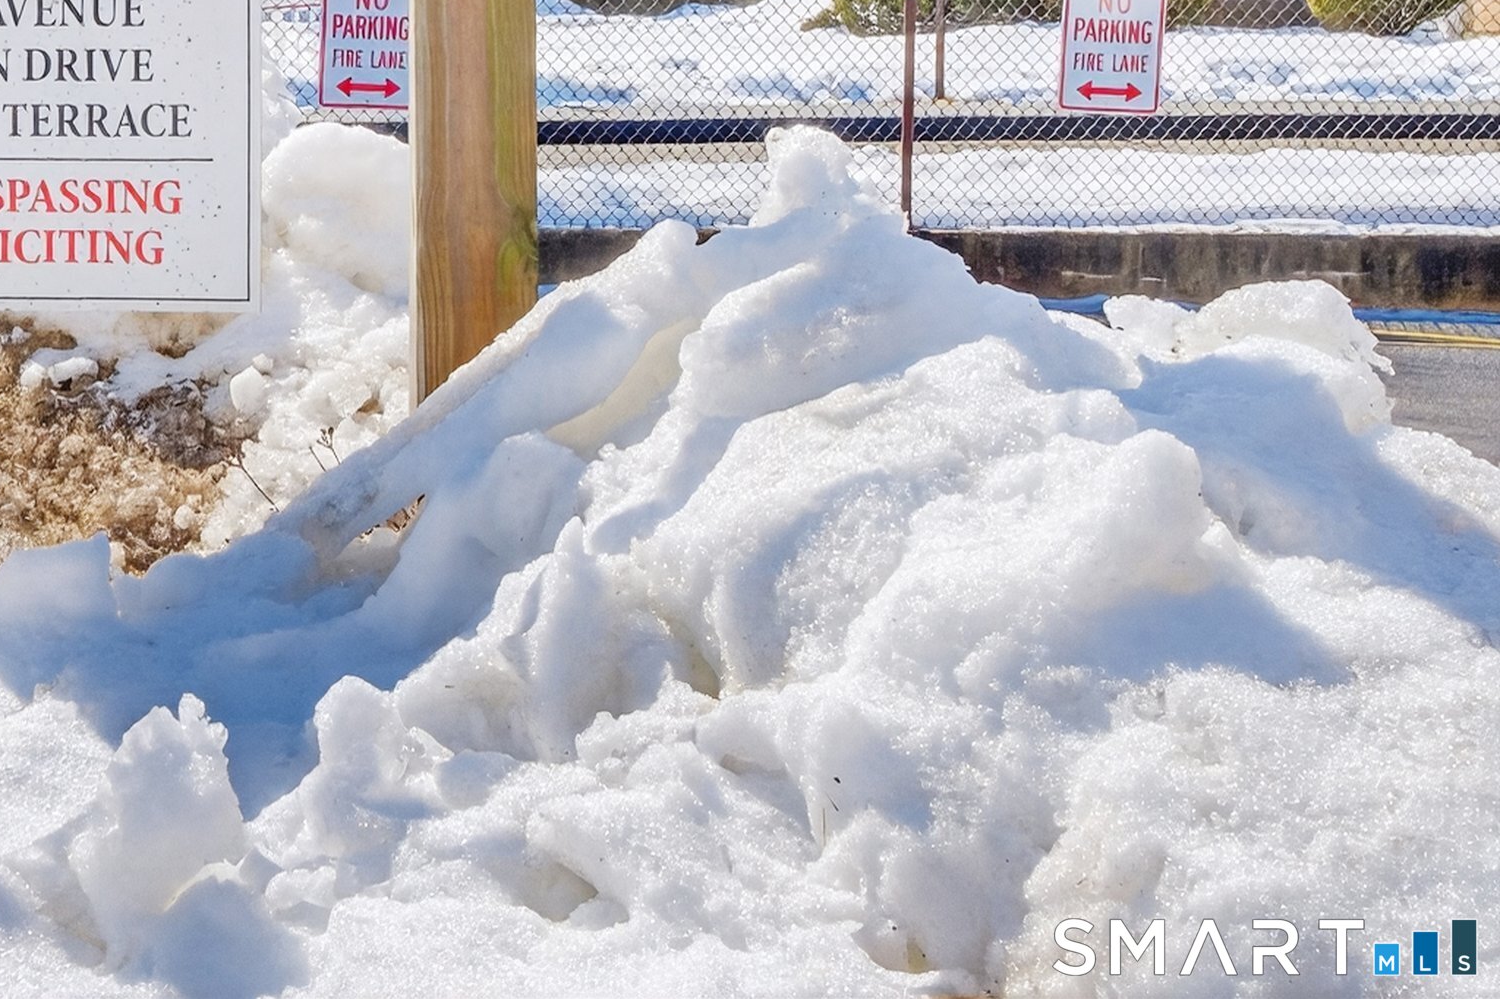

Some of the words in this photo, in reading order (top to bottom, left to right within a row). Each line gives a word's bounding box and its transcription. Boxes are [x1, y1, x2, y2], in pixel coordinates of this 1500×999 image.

[332, 14, 409, 41] PARKING
[1073, 17, 1153, 44] PARKING
[23, 48, 154, 82] DRIVE
[332, 48, 363, 68] FIRE
[370, 50, 407, 70] LANE
[1073, 52, 1104, 72] FIRE
[1112, 54, 1149, 73] LANE
[3, 103, 193, 138] TERRACE
